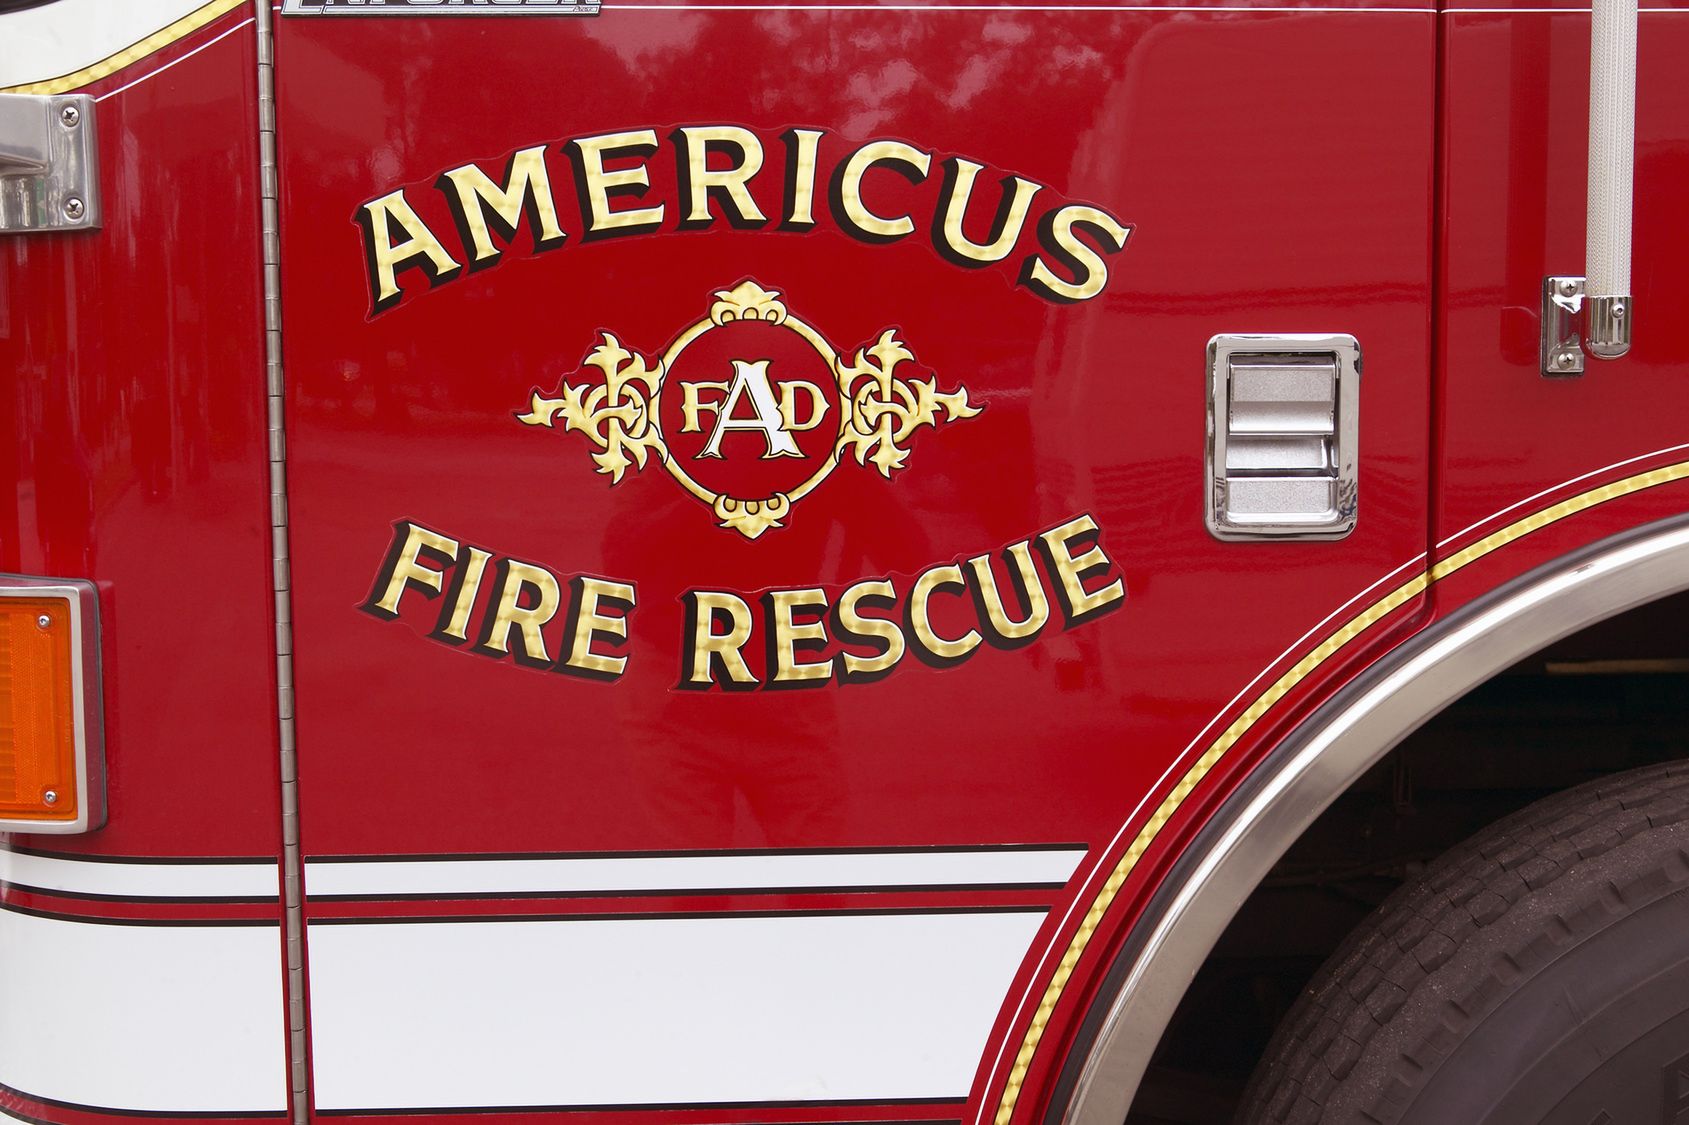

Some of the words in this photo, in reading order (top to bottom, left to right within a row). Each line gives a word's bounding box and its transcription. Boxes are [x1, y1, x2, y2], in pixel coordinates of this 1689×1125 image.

[357, 125, 1131, 312] AMERICUS
[367, 522, 636, 678] FIRE
[682, 514, 1124, 688] RESCUE
